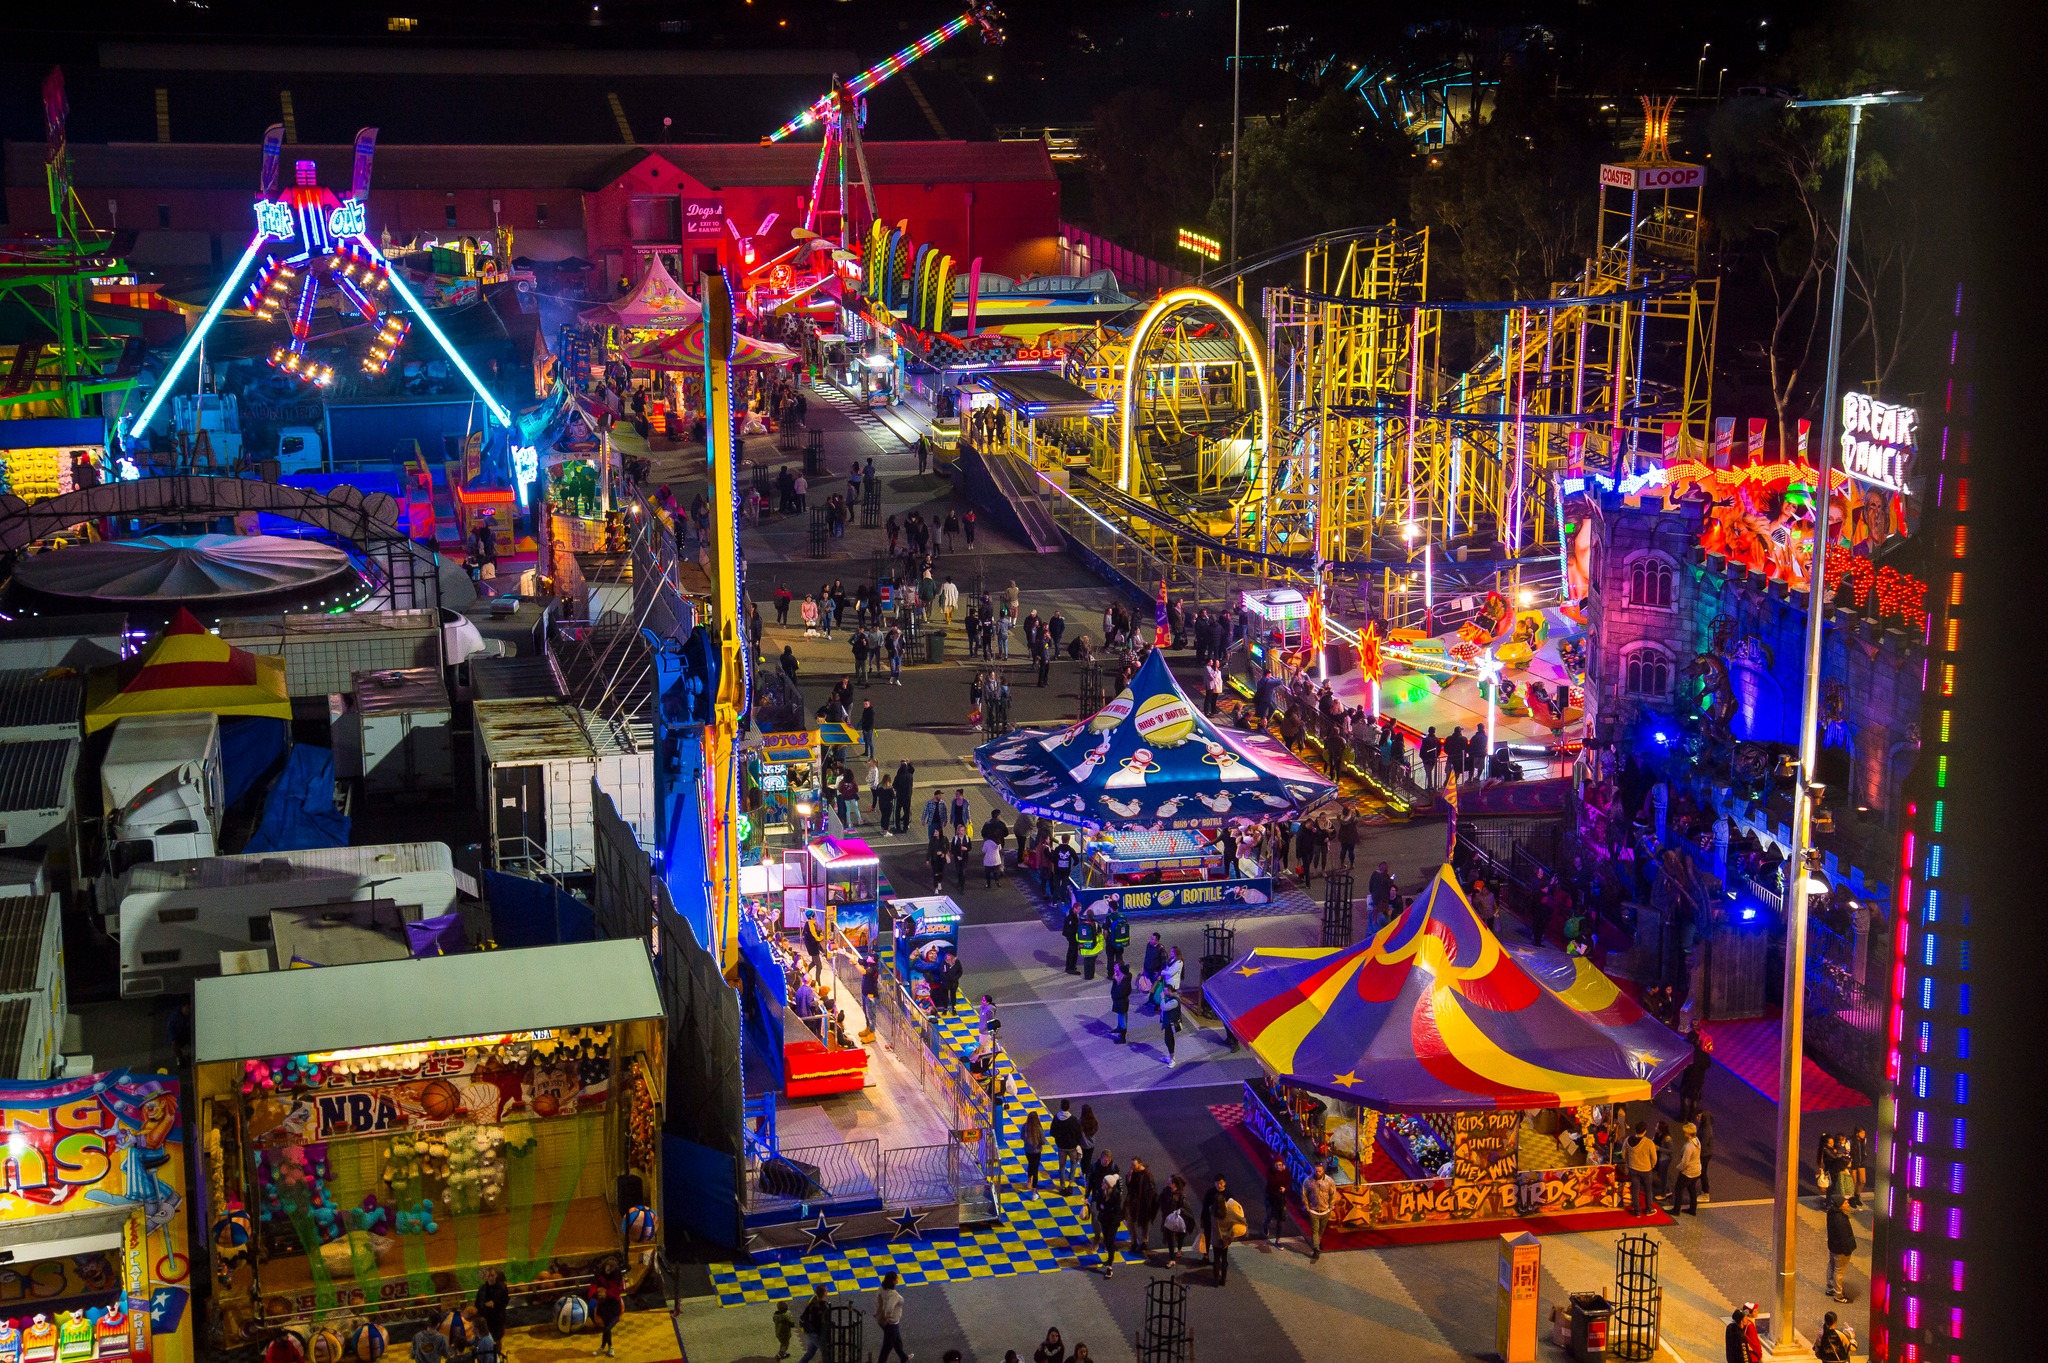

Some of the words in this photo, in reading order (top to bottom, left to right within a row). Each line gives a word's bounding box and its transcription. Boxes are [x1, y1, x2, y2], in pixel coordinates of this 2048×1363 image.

[1602, 168, 1632, 186] COASTER
[1645, 170, 1699, 186] LOOP
[686, 204, 713, 219] Dogs
[1843, 393, 1915, 446] BREAK
[1137, 717, 1156, 730] RING
[1164, 707, 1189, 721] BOTTLE
[763, 732, 809, 747] HOTOS
[1173, 820, 1187, 829] RING
[1202, 817, 1222, 827] BOTTLE
[1123, 892, 1151, 909] RING
[1181, 887, 1223, 905] BOTTLE
[532, 1029, 552, 1040] NBA
[0, 1099, 105, 1133] NG
[319, 1093, 397, 1137] NBA
[1457, 1116, 1484, 1132] KIDS
[1488, 1114, 1518, 1129] PLAY
[1469, 1137, 1502, 1149] UNTIL
[1456, 1159, 1486, 1182] THEY
[1489, 1154, 1518, 1180] WIN
[1400, 1185, 1493, 1216] ANGRY
[1499, 1179, 1580, 1209] BIRDS
[129, 1250, 142, 1297] PLAYER
[133, 1313, 145, 1351] PRIZE
